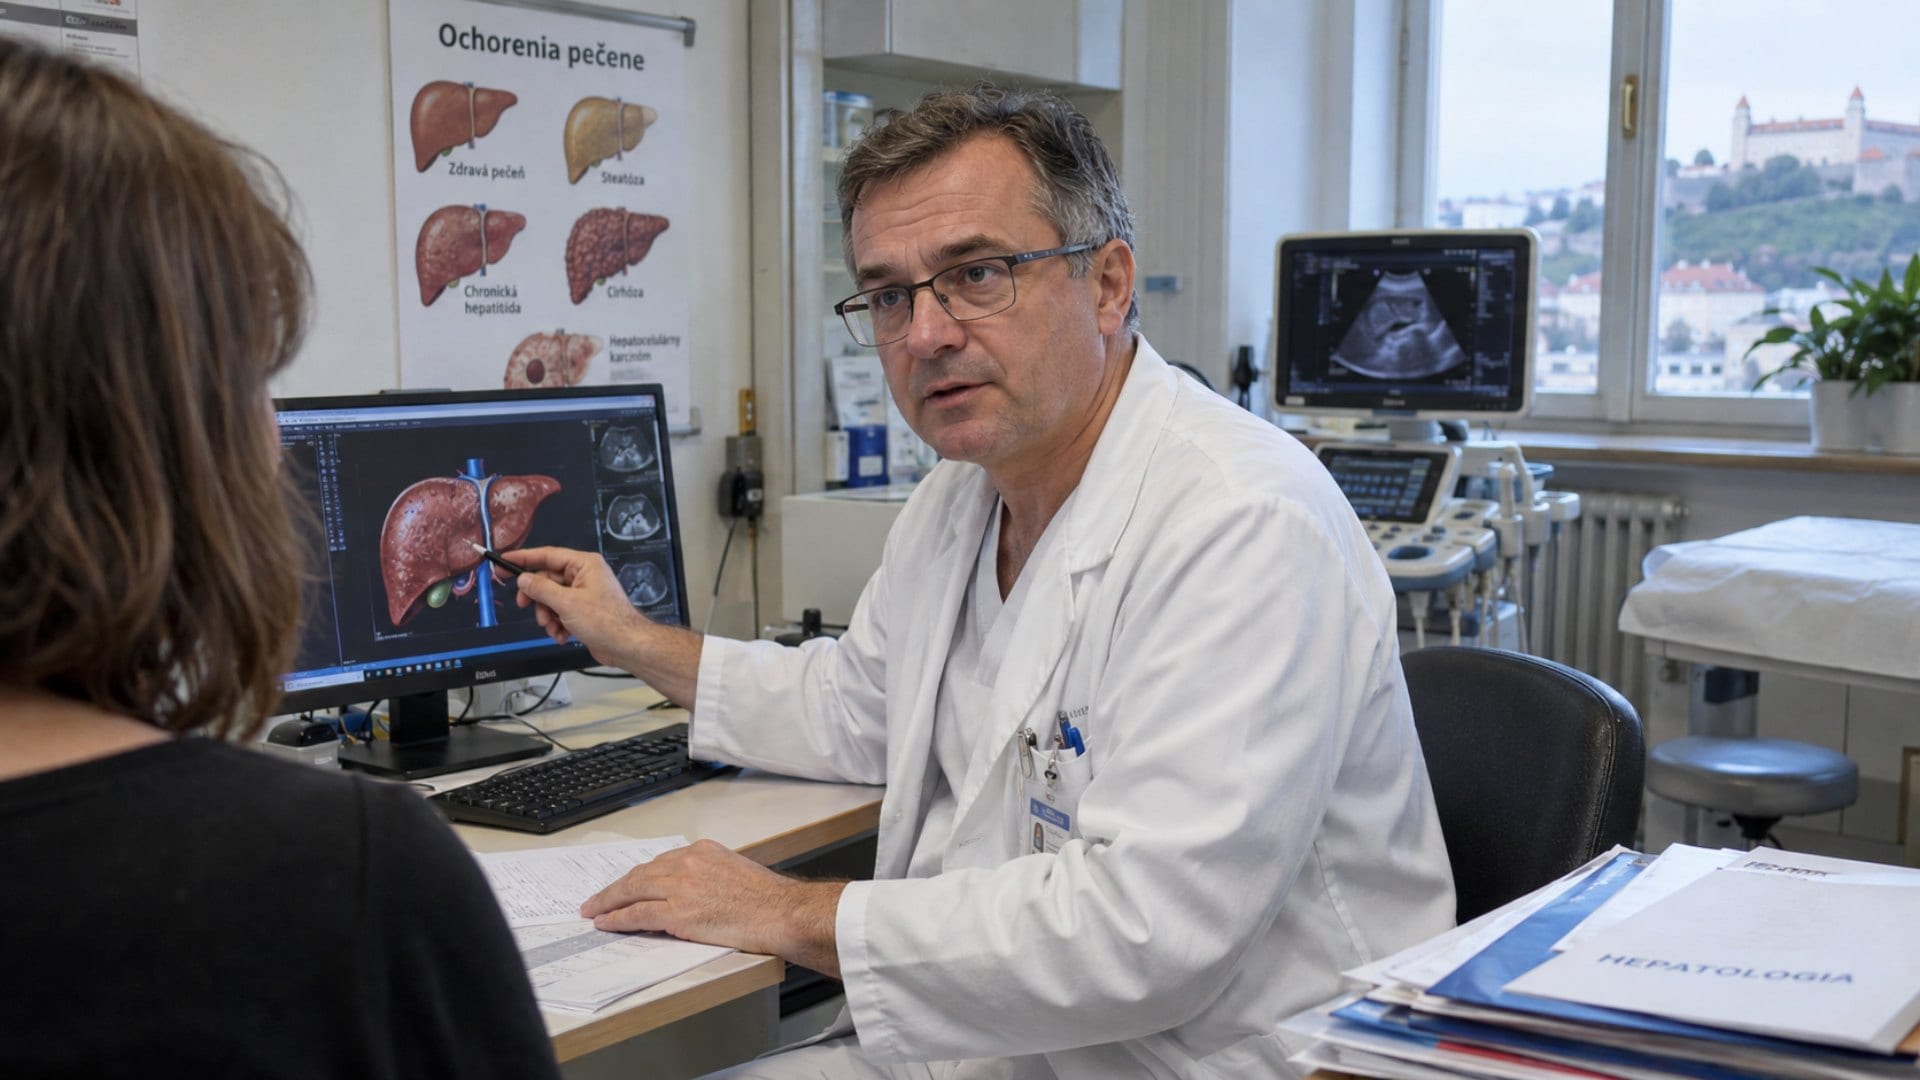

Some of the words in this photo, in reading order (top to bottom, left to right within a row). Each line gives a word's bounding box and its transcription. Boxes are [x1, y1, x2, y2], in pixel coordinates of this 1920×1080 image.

[438, 22, 561, 62] Ochorenia
[568, 42, 646, 72] pečene
[448, 161, 489, 177] Zdravá
[601, 171, 646, 187] Steatóza
[464, 284, 518, 298] Chronická
[607, 285, 644, 299] Cirhóza
[465, 301, 522, 317] hepatitida
[1597, 953, 1854, 984] HEPATOLOGIA
